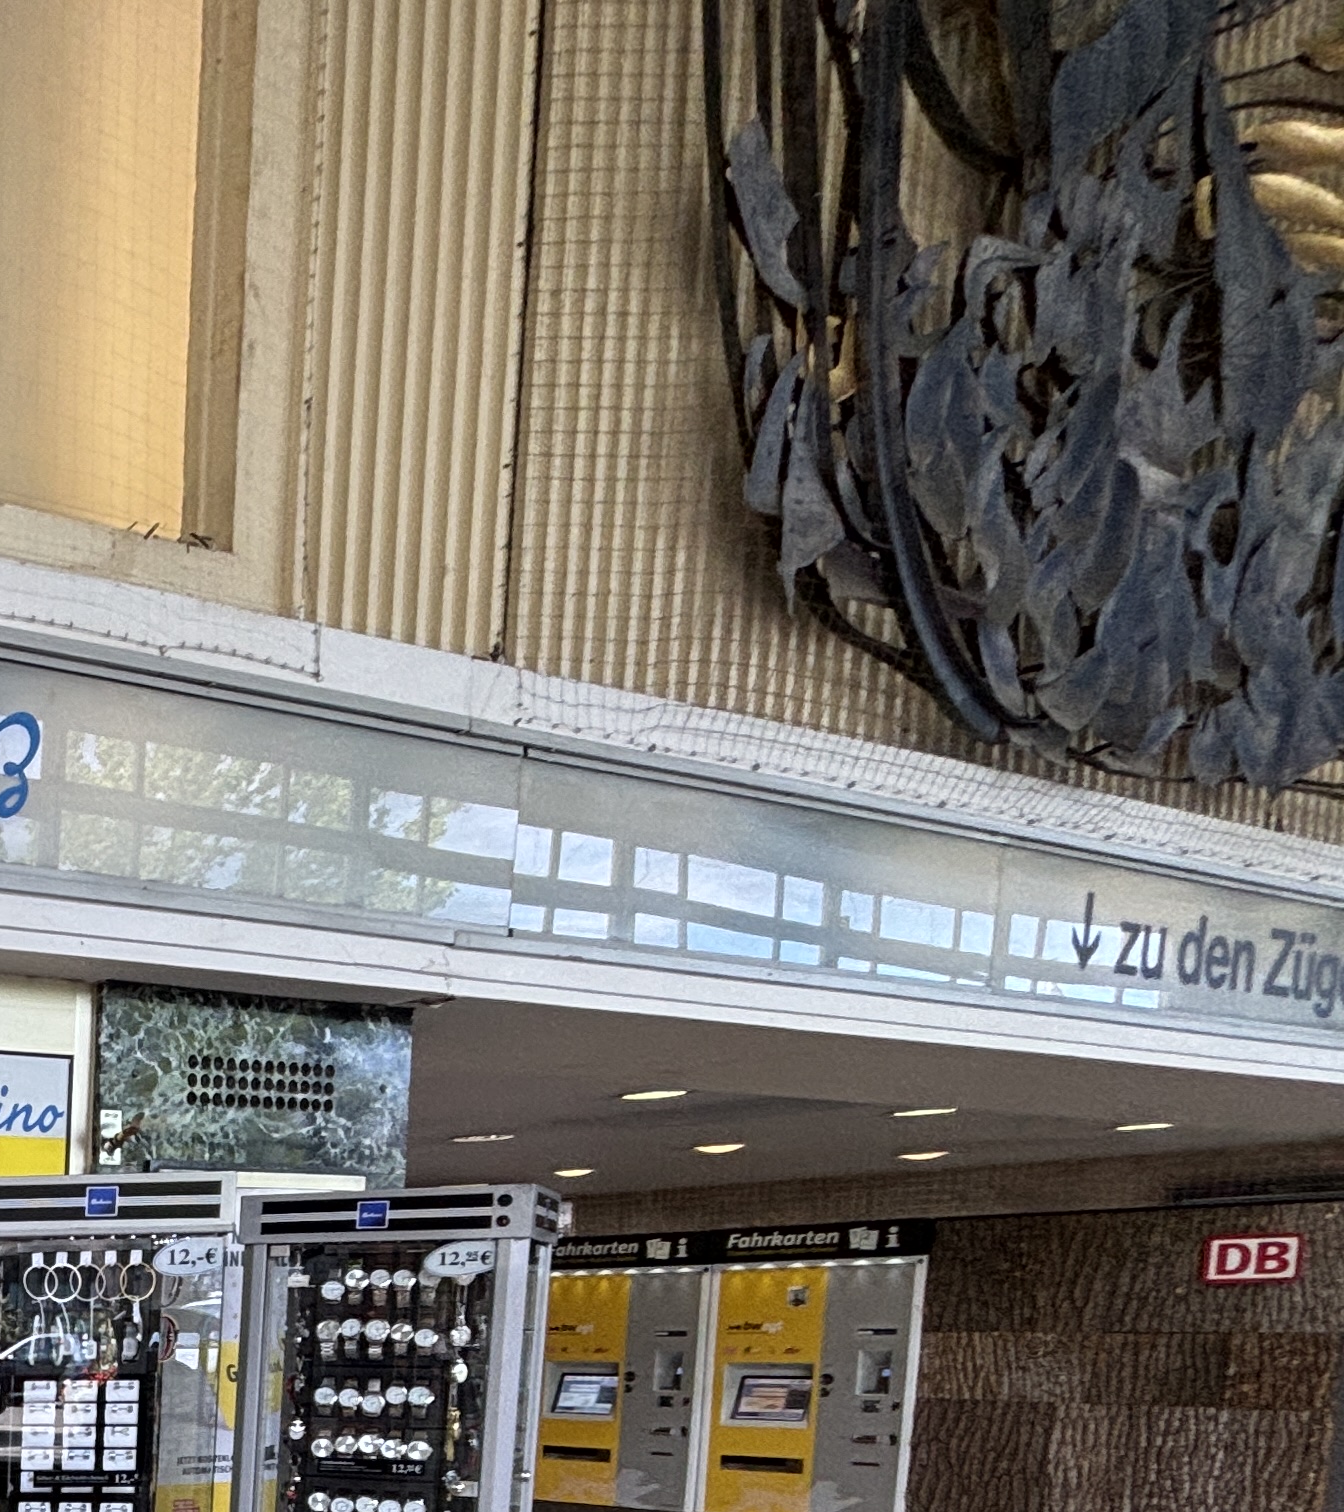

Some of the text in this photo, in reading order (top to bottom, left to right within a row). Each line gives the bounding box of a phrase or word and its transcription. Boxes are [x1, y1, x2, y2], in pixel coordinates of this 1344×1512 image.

[1114, 921, 1167, 980] zu
[1177, 914, 1256, 992] den
[727, 1229, 839, 1250] Fahrkarten
[1214, 1241, 1291, 1277] DB
